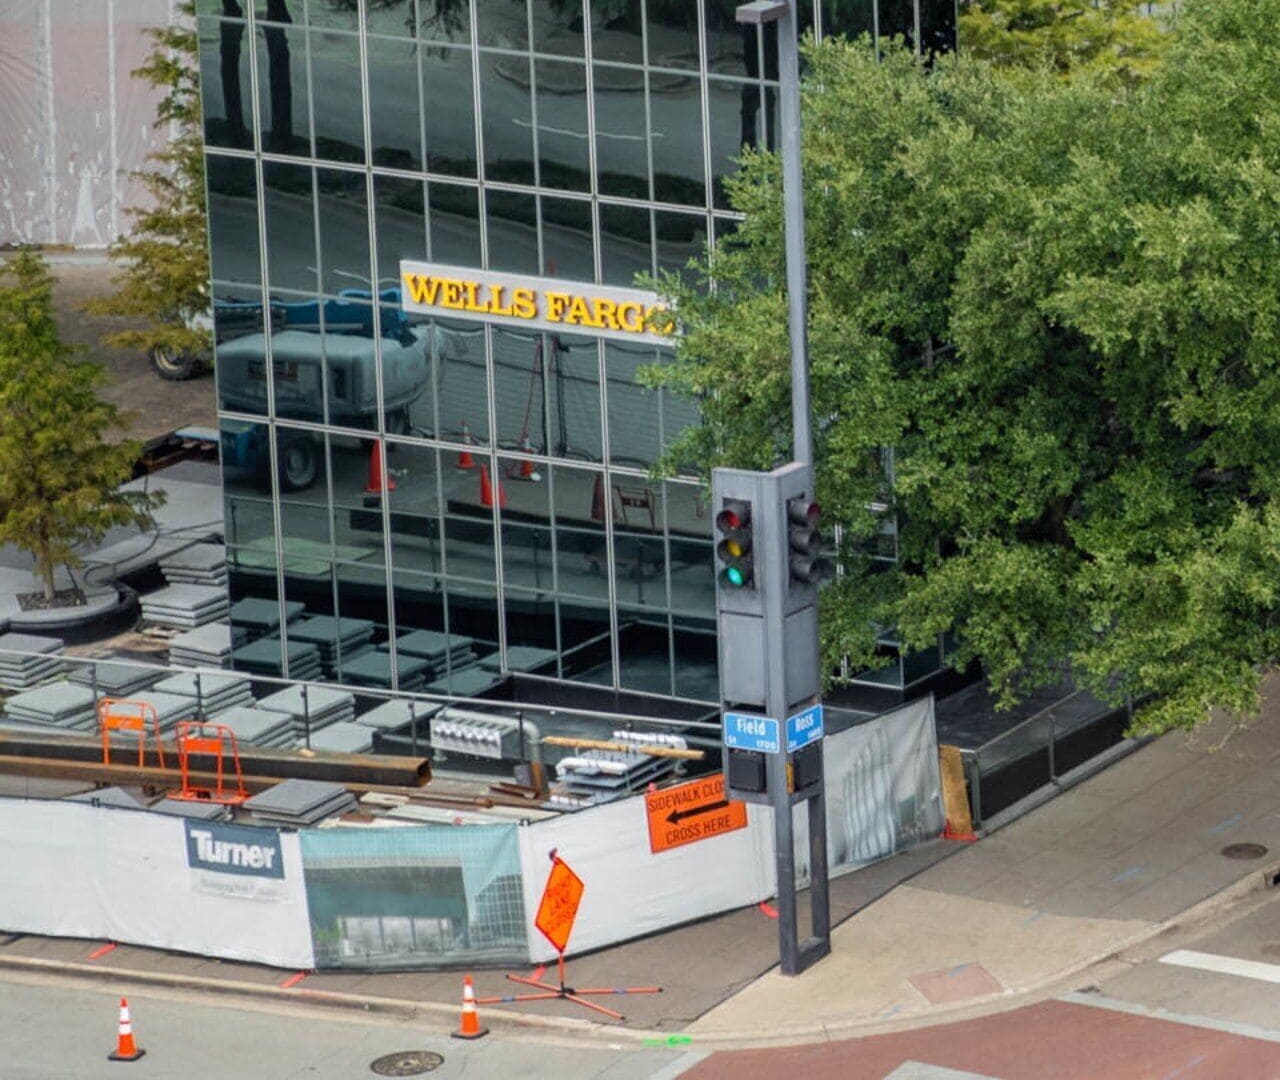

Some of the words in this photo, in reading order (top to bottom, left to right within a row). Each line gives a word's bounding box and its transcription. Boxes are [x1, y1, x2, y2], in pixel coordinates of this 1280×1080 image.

[404, 273, 538, 319] WELLS
[544, 291, 675, 334] FARGO
[736, 718, 766, 735] Field
[648, 786, 701, 812] SIDEWALK
[702, 779, 725, 797] CLO
[666, 823, 701, 844] CROSS
[702, 814, 732, 834] HERE
[190, 829, 276, 869] Turner
